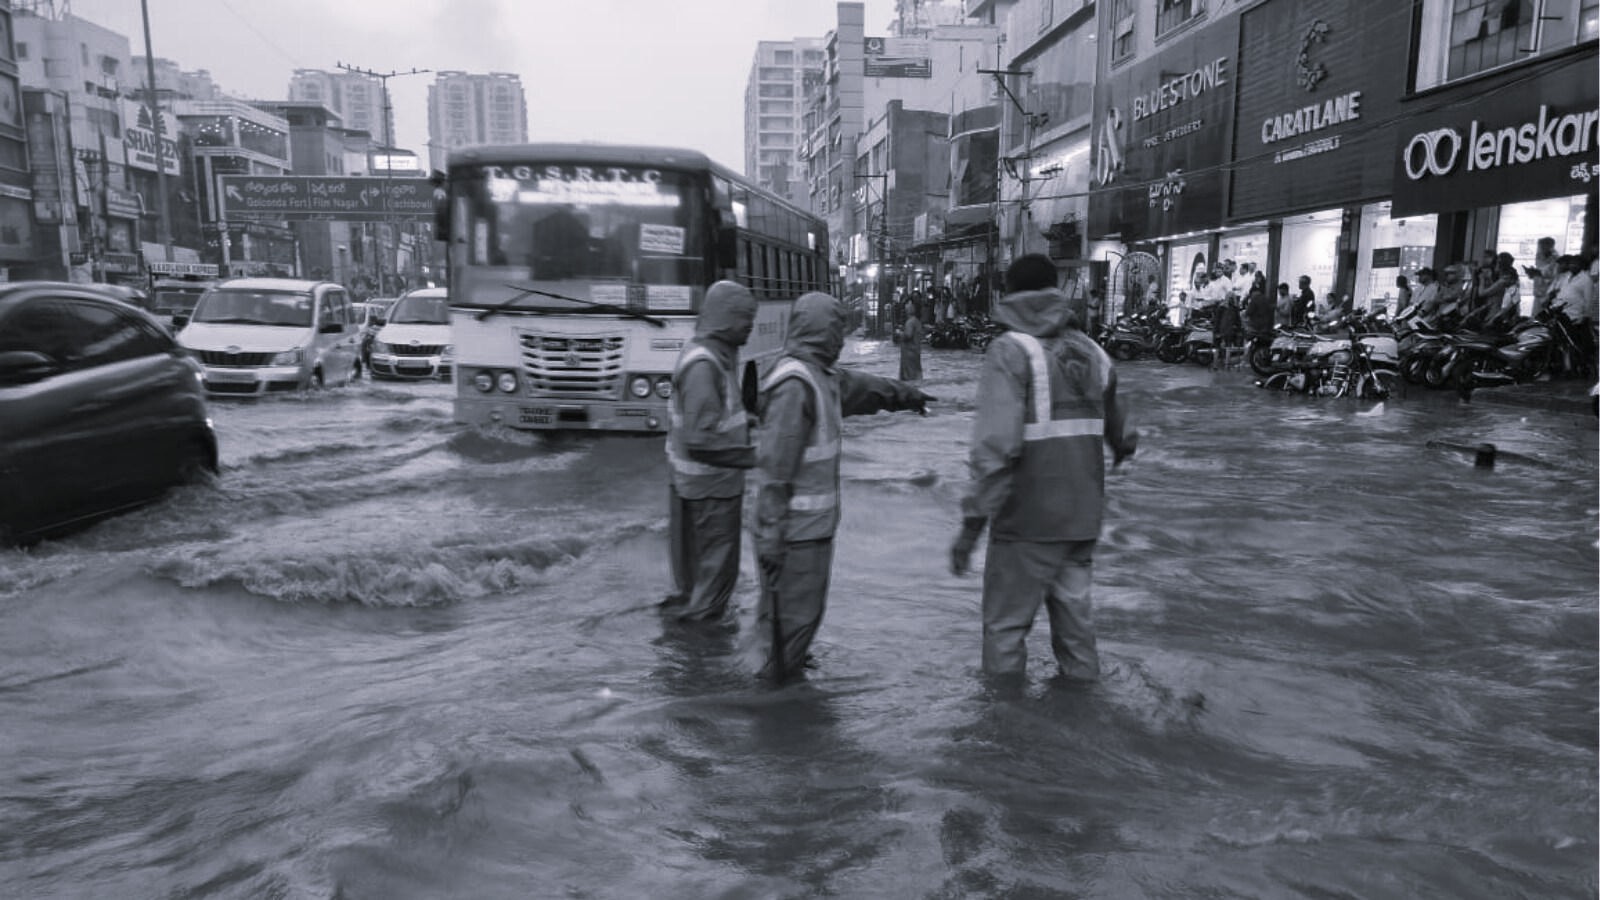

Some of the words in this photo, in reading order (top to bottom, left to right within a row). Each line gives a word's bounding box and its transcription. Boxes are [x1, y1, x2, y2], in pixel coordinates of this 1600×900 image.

[1134, 57, 1226, 121] BLUESTONE
[1262, 91, 1361, 144] CARATLANE
[1467, 104, 1600, 171] lenskar
